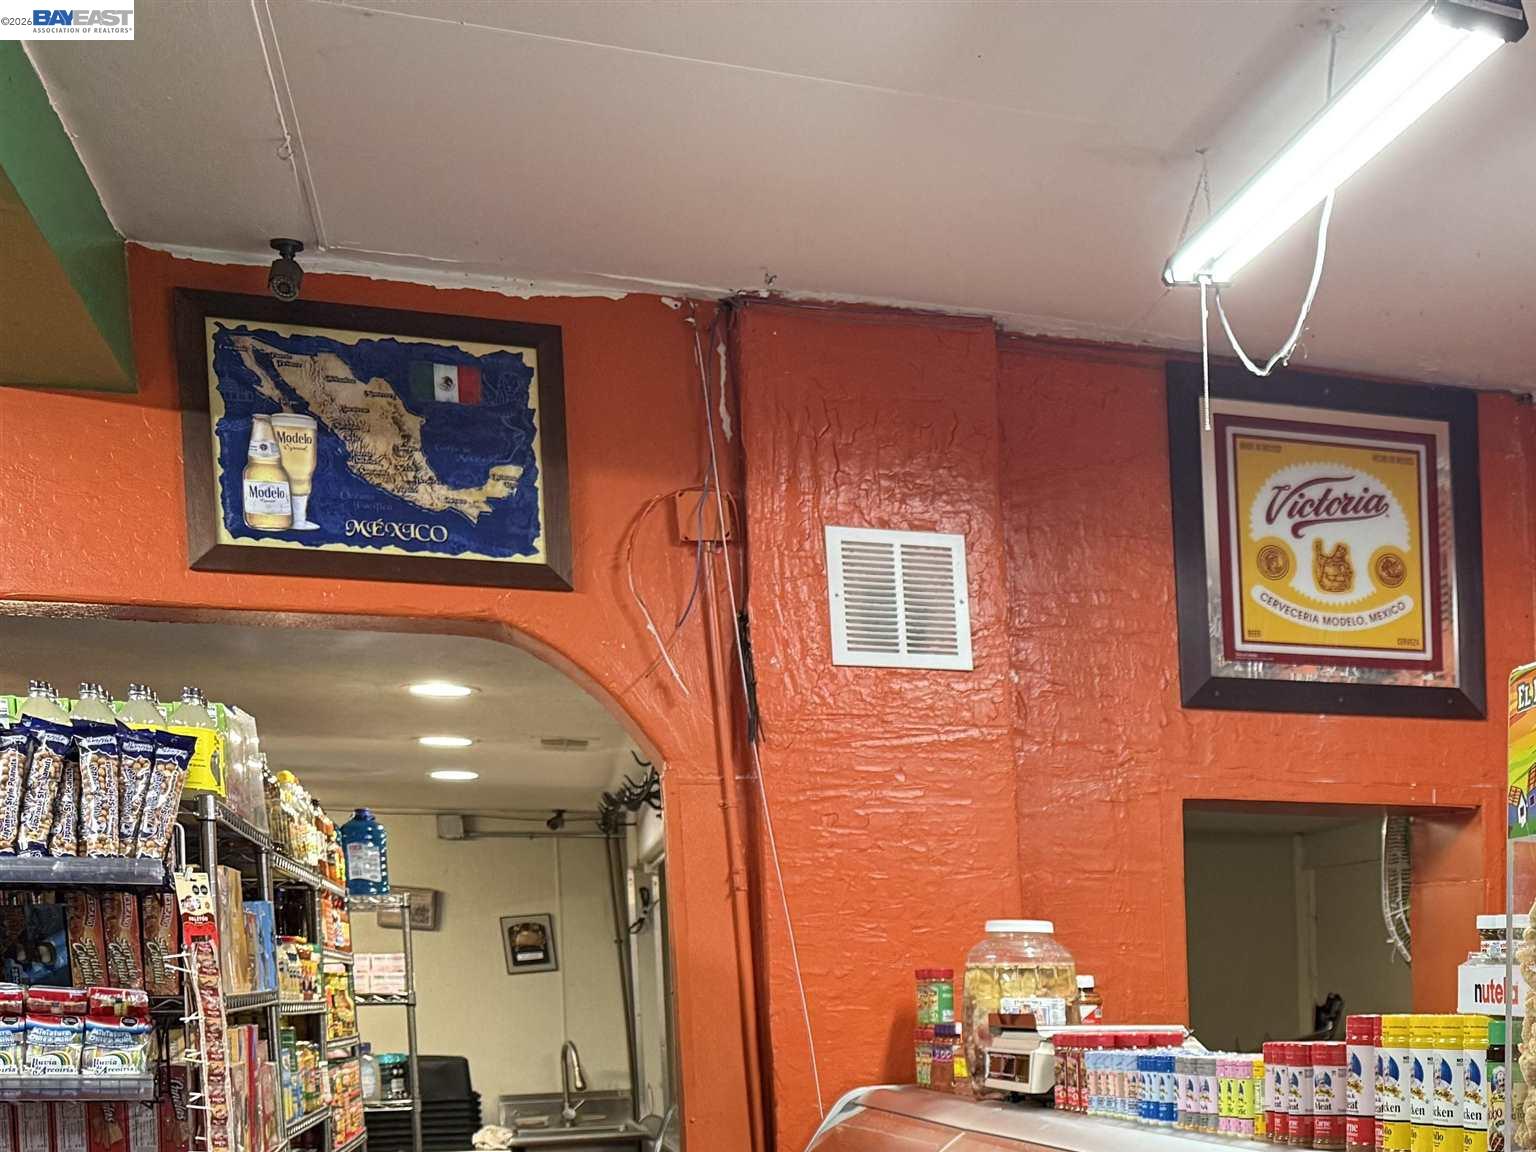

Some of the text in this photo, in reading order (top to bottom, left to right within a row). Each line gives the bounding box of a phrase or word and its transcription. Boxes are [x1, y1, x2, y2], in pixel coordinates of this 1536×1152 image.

[277, 431, 313, 445] Modelo
[249, 484, 286, 499] Modelo
[1266, 474, 1389, 539] Victoria
[345, 519, 448, 543] MÉXICO
[1369, 602, 1406, 623] MEXICO
[1517, 684, 1532, 709] EL
[1474, 976, 1519, 1005] nutela
